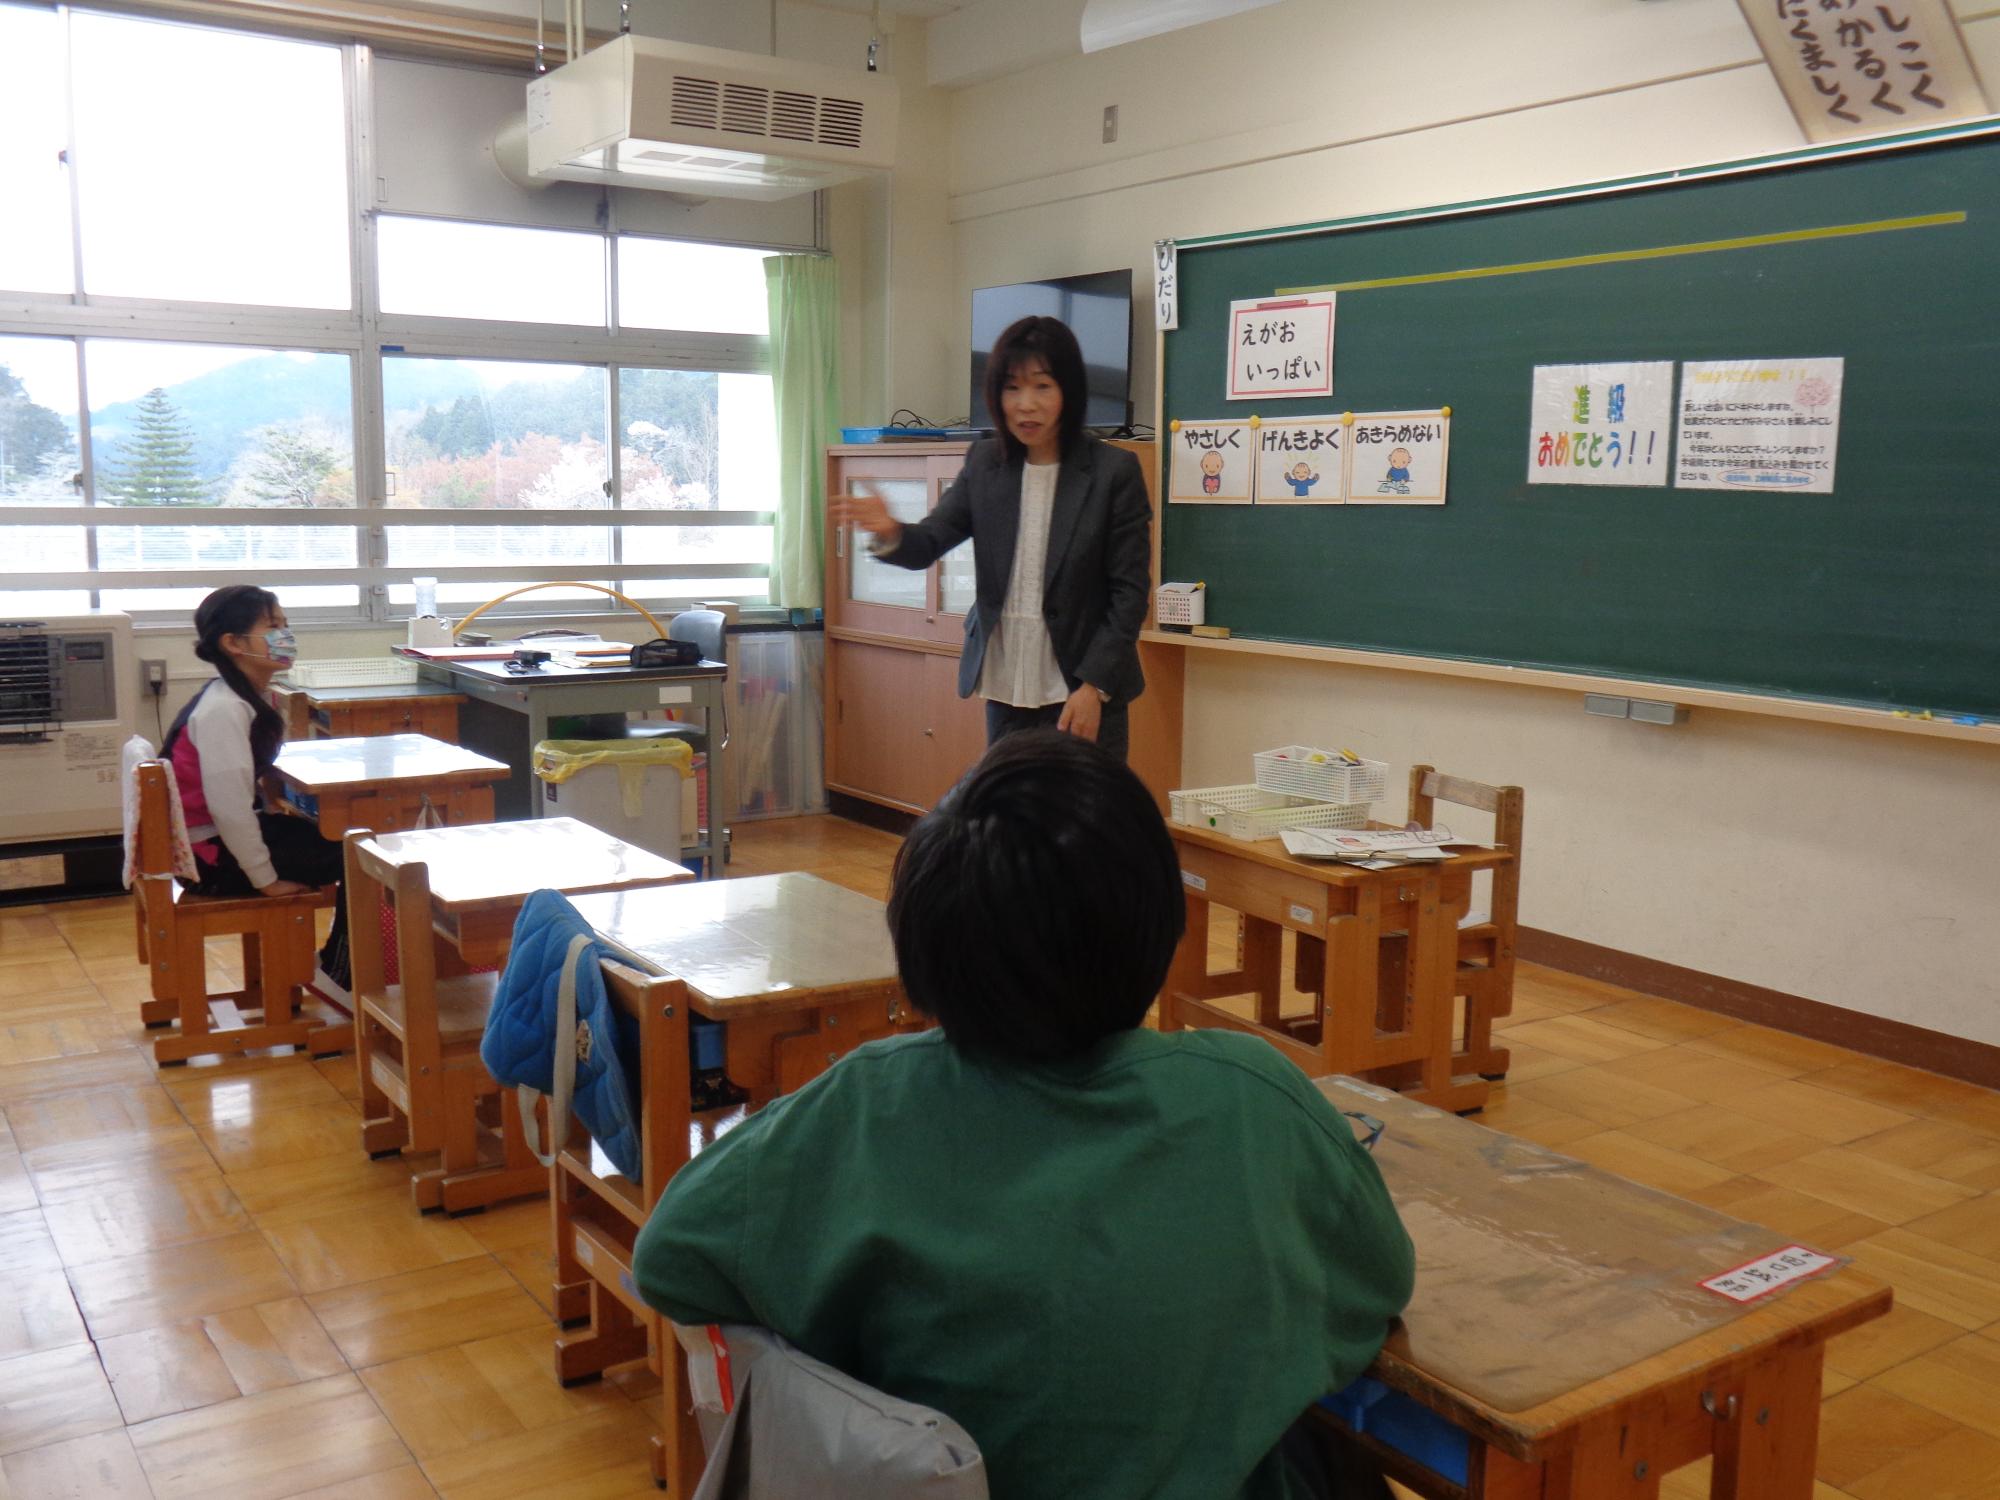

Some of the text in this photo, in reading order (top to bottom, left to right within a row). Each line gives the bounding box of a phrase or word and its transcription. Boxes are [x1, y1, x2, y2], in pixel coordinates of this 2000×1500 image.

[1158, 247, 1173, 324] ひだり
[1242, 320, 1296, 346] えがお
[1246, 355, 1321, 381] いっぱい
[1184, 428, 1240, 450] やさしく
[1261, 428, 1339, 452] げんきよく
[1355, 424, 1441, 444] あきらめない
[1538, 430, 1656, 469] おめでとう!!
